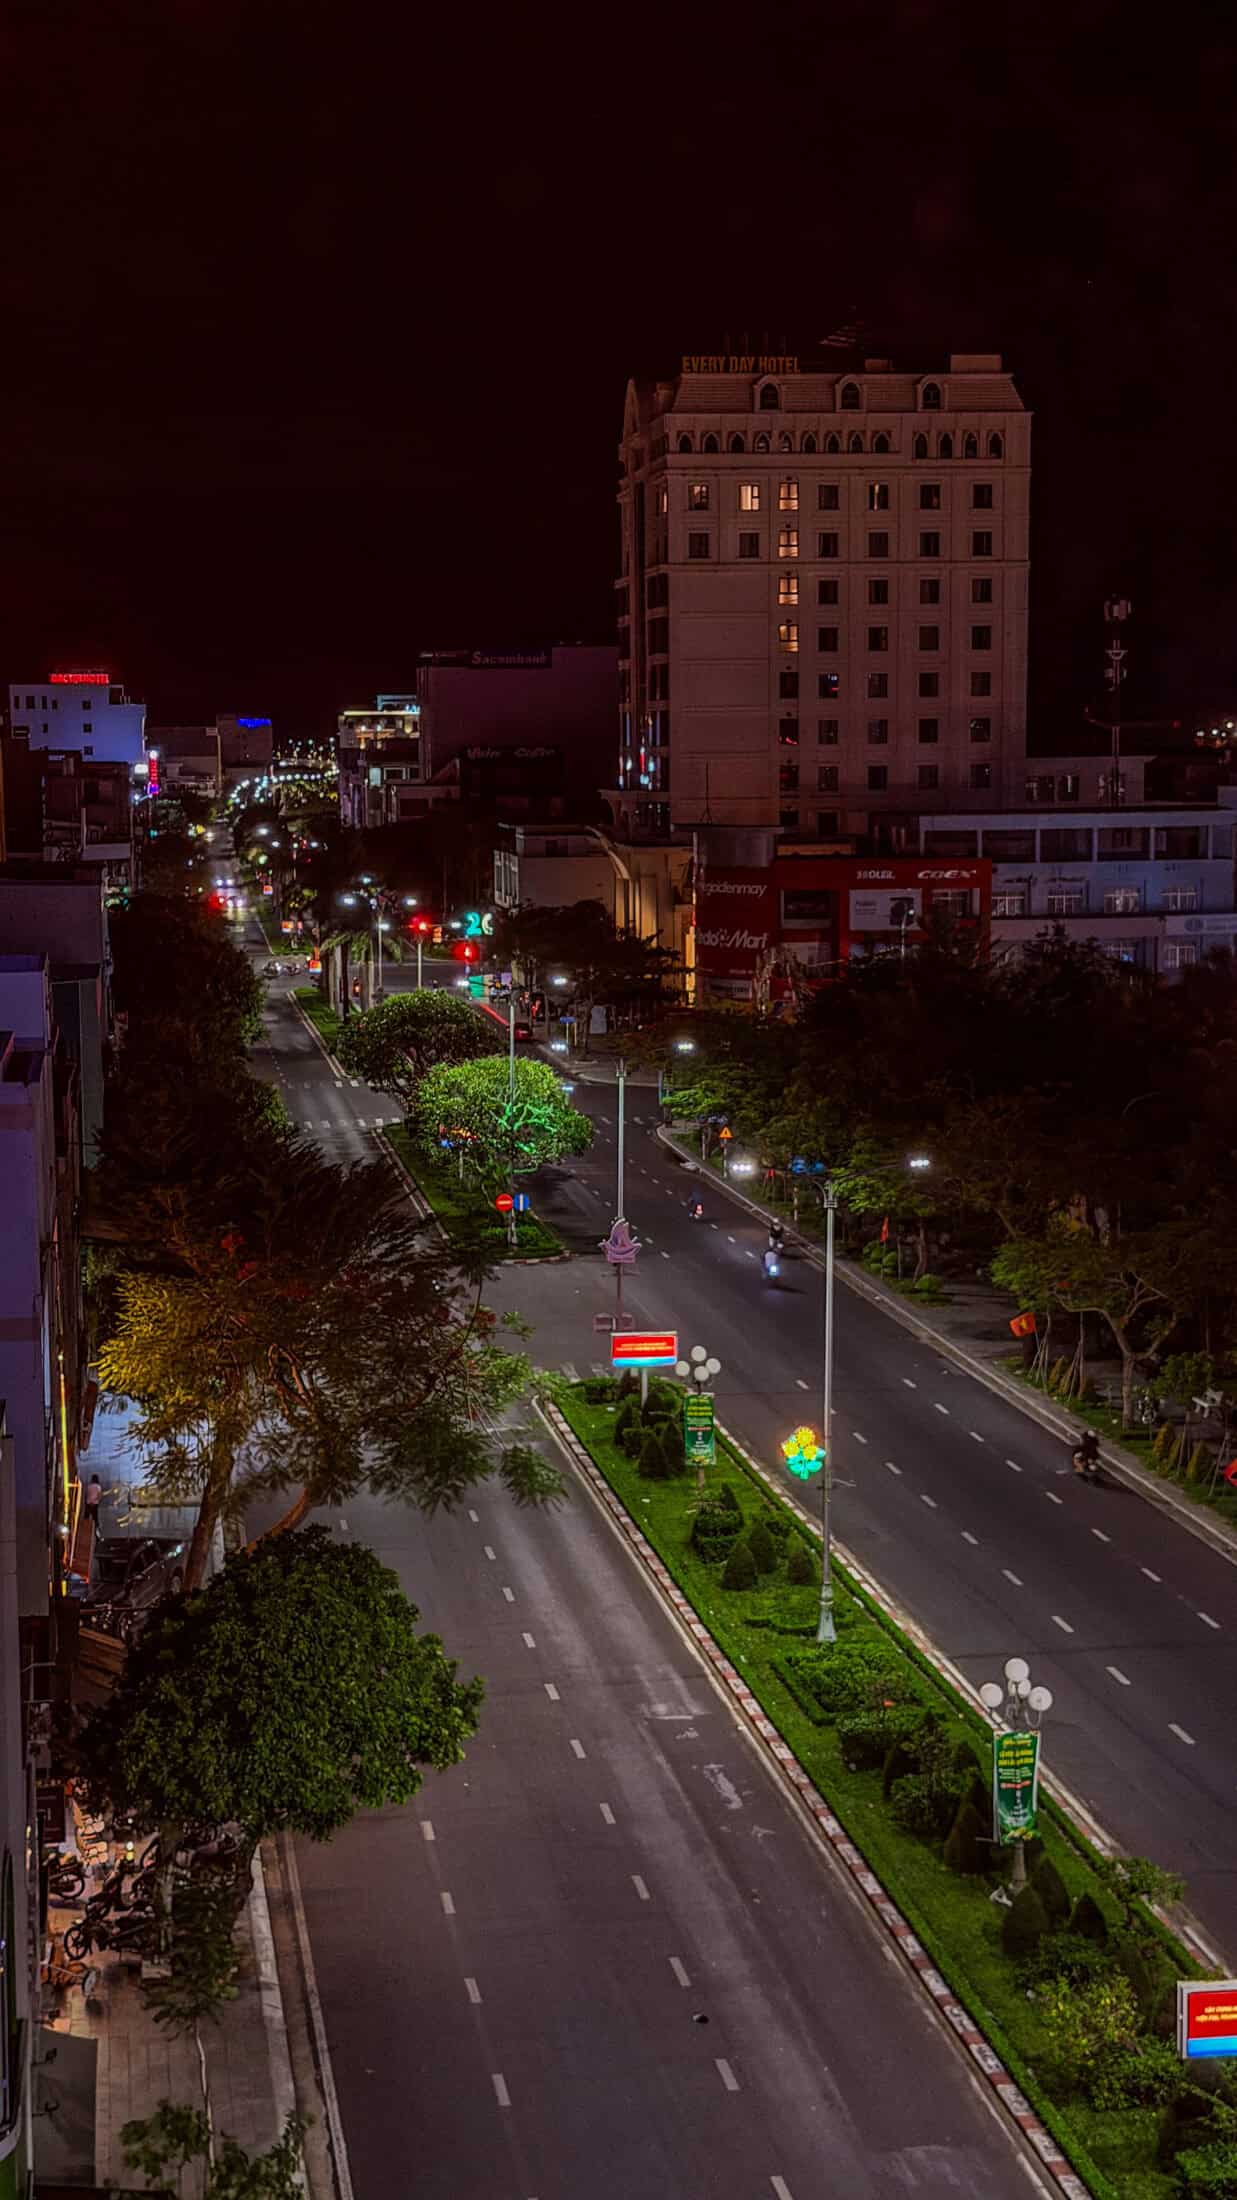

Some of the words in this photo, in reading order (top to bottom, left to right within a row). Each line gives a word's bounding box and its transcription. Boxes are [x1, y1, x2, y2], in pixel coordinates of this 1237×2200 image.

[681, 355, 726, 373] EVERY
[729, 355, 756, 373] DAY
[759, 355, 800, 373] HOTEL
